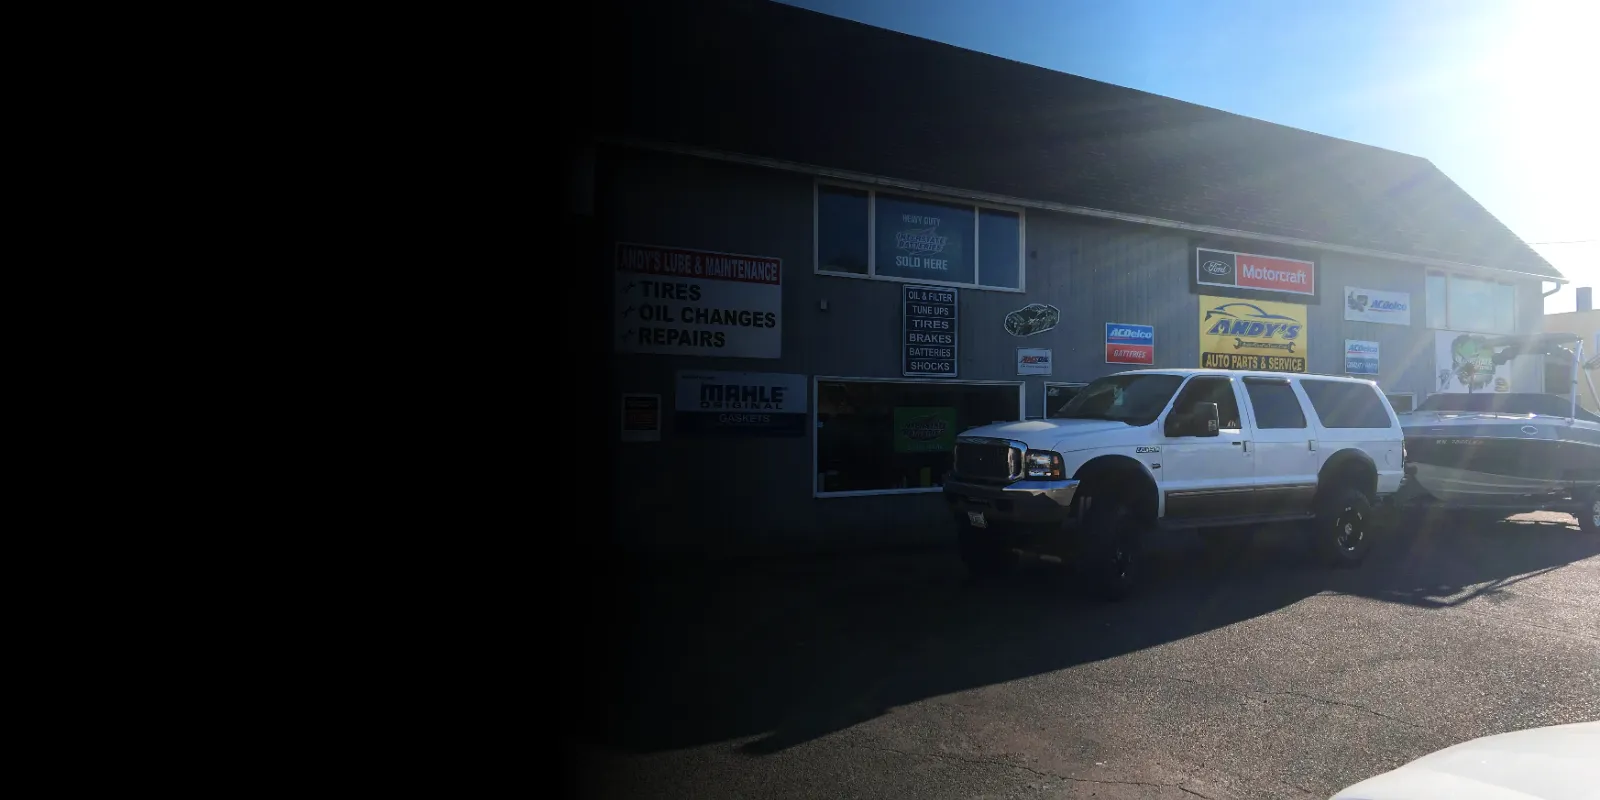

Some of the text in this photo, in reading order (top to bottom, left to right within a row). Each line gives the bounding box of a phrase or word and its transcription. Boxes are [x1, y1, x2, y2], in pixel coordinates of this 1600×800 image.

[902, 214, 941, 227] HEAVY DUTY
[619, 247, 777, 281] ANDY'S LUBE & MAINTENANCE
[896, 255, 948, 270] SOLD HERE
[1208, 261, 1307, 285] Ford Motorcraft
[638, 280, 702, 301] TIRES
[908, 291, 953, 302] OIL & FILTER
[639, 304, 776, 328] OIL CHANGES
[912, 305, 949, 316] TUNE UPS
[912, 319, 949, 329] TIRES
[1206, 317, 1302, 340] ANDY'S
[638, 327, 726, 348] REPAIRS
[909, 333, 952, 344] BRAKES
[1110, 328, 1152, 339] ACDelco
[909, 347, 951, 357] BATTERIES
[911, 361, 950, 371] SHOCKS
[1206, 354, 1302, 371] AUTO PARTS & SERVICE
[700, 383, 784, 403] MAHLE
[700, 401, 783, 410] ORIGINAL
[719, 413, 771, 423] GASKETS
